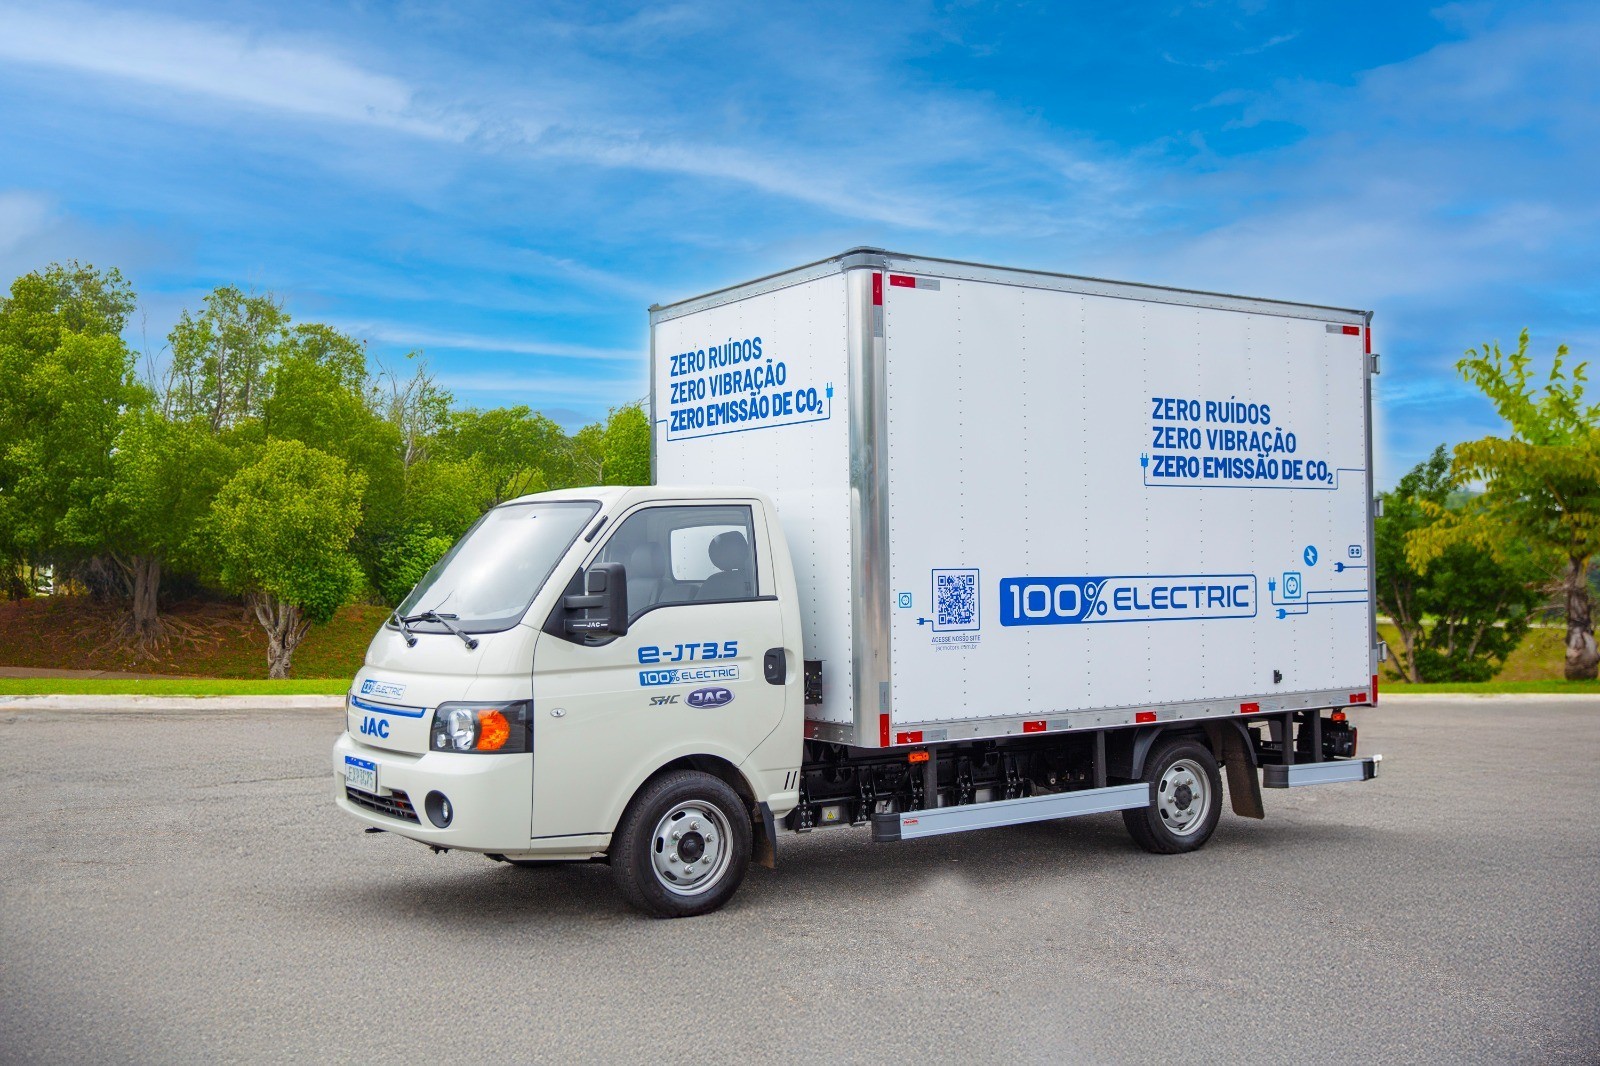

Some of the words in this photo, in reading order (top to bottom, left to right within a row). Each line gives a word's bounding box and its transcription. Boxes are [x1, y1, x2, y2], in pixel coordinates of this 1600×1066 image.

[670, 349, 706, 377] ZERO
[708, 336, 763, 369] RUÍDOS
[670, 377, 706, 405] ZERO
[709, 358, 787, 398] VIBRAÇÃO
[670, 406, 705, 432] ZERO
[706, 392, 770, 427] EMISSÃO
[772, 391, 793, 417] DE
[1151, 397, 1201, 422] ZERO
[1205, 395, 1271, 425] RUÍDOS
[1152, 426, 1201, 450] ZERO
[1205, 426, 1297, 457] VIBRAÇÃO
[1152, 454, 1200, 478] ZERO
[1203, 453, 1279, 481] EMISSÃO
[1281, 459, 1304, 481] DE
[1009, 579, 1109, 620] 100%
[1113, 584, 1250, 611] ELECTRIC
[637, 640, 738, 664] e-JT3.5
[642, 669, 680, 684] 100%
[681, 668, 736, 680] ELECTRIC
[691, 690, 728, 704] JAC
[360, 716, 390, 739] JAC
